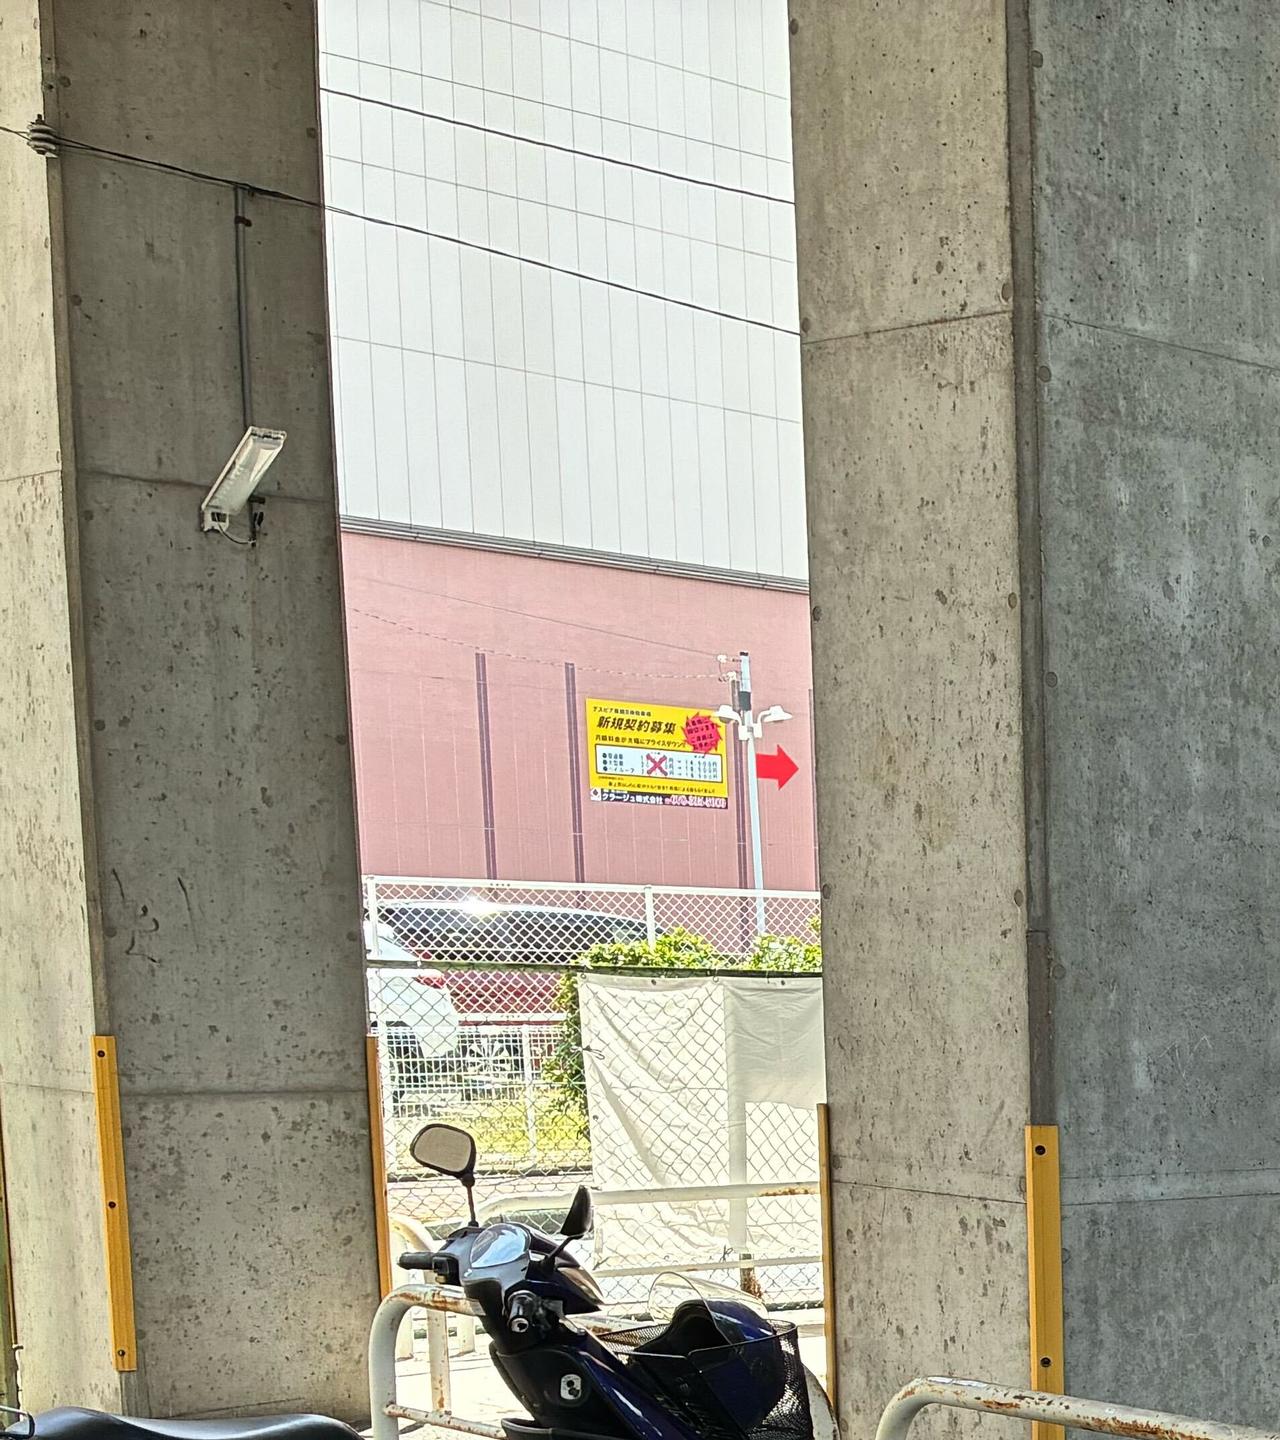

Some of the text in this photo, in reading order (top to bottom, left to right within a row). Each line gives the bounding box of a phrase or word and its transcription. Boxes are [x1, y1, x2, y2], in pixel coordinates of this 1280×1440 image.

[596, 715, 677, 736] 新規契約募集
